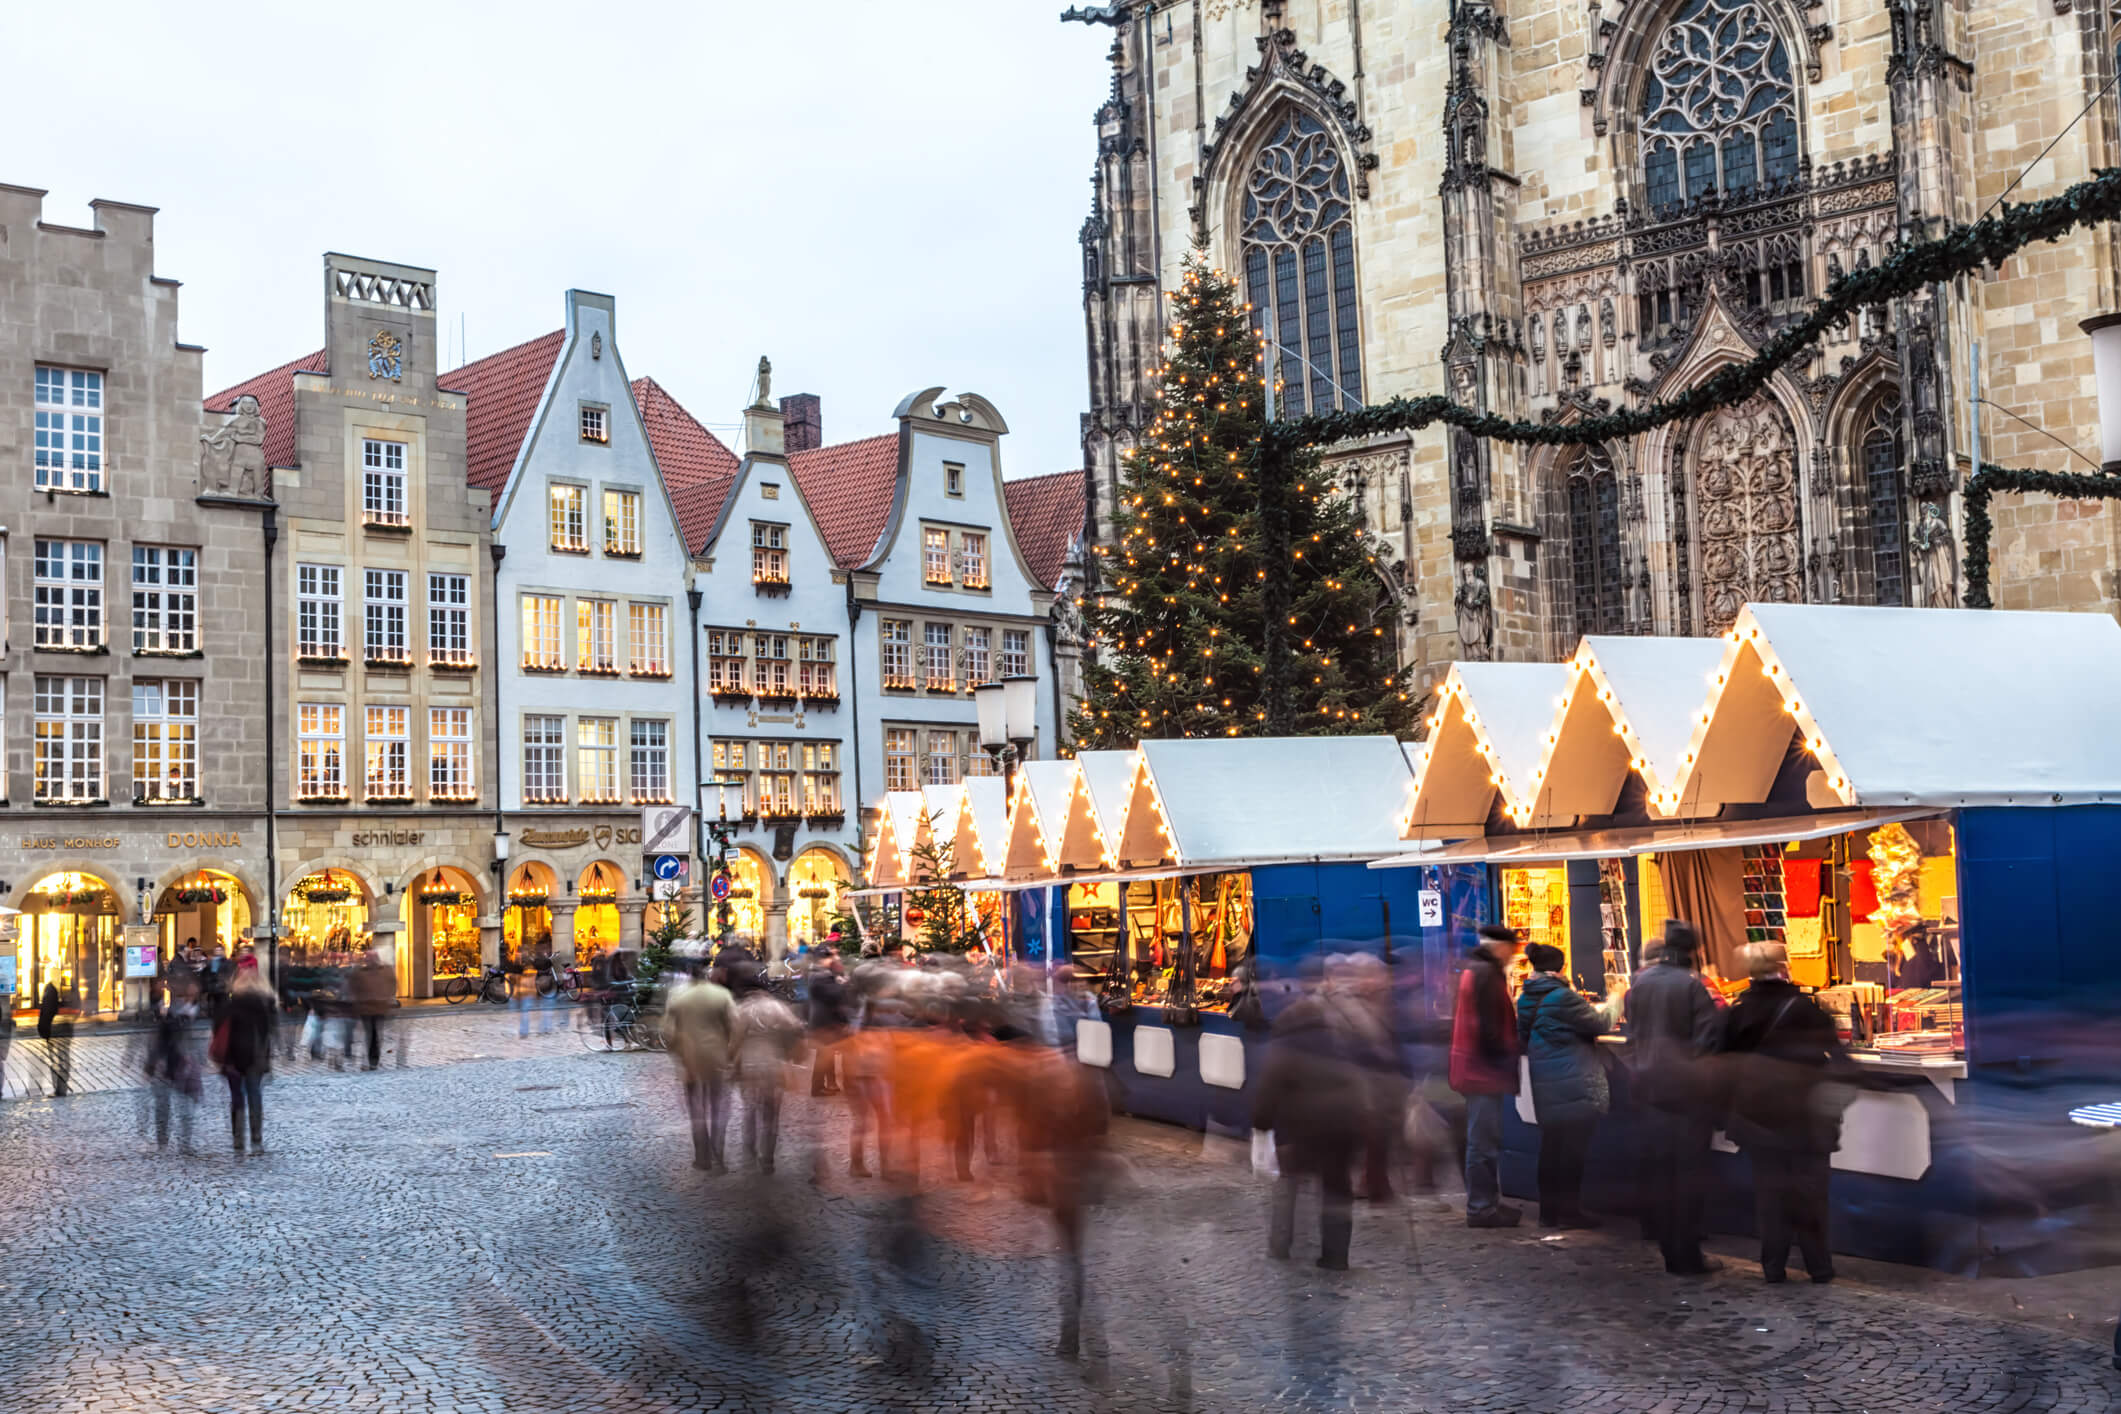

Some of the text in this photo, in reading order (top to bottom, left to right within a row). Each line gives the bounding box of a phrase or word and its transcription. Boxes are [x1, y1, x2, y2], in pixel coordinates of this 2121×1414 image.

[22, 839, 56, 849] HAUS
[168, 832, 241, 848] DONNA
[352, 829, 425, 847] schnitzler
[1422, 898, 1438, 907] WC
